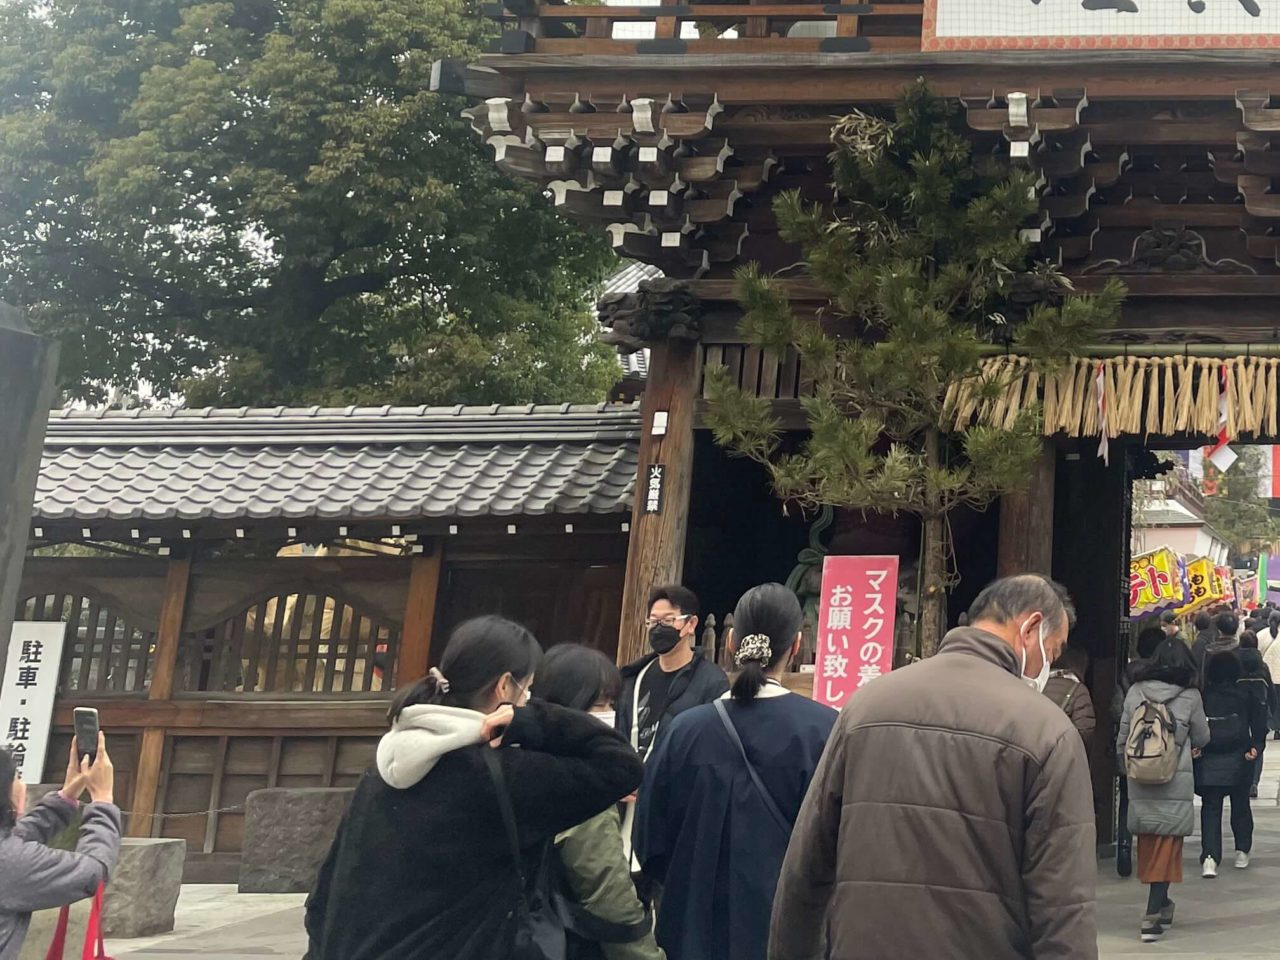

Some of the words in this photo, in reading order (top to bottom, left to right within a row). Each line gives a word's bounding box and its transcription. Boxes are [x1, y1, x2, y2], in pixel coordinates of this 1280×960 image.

[824, 585, 853, 711] お願い致し
